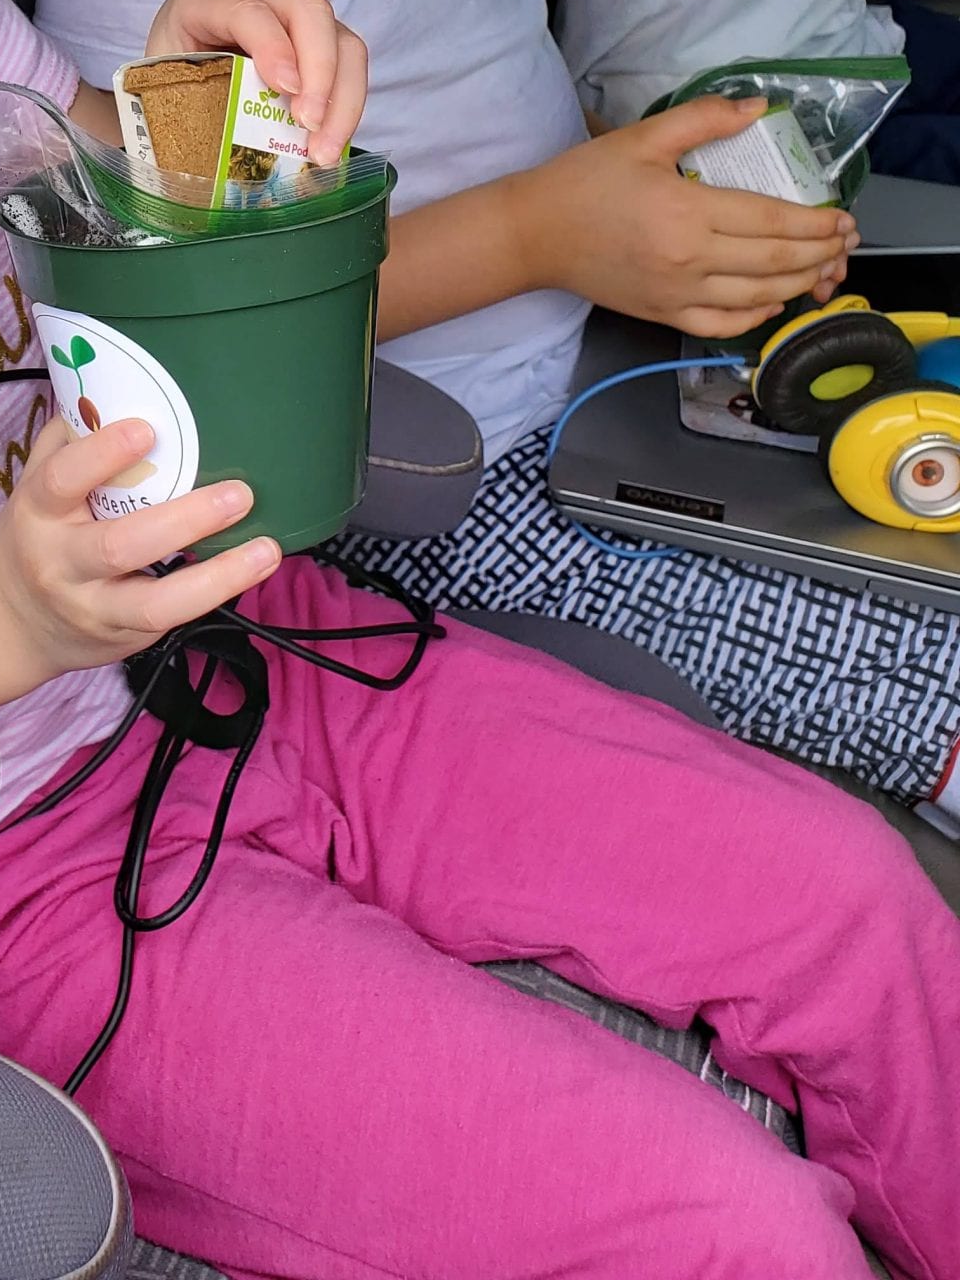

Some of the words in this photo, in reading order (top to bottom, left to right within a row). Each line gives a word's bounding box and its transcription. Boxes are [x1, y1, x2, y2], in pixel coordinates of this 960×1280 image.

[243, 100, 285, 123] GROW
[268, 137, 291, 154] Seed
[89, 489, 152, 515] udents
